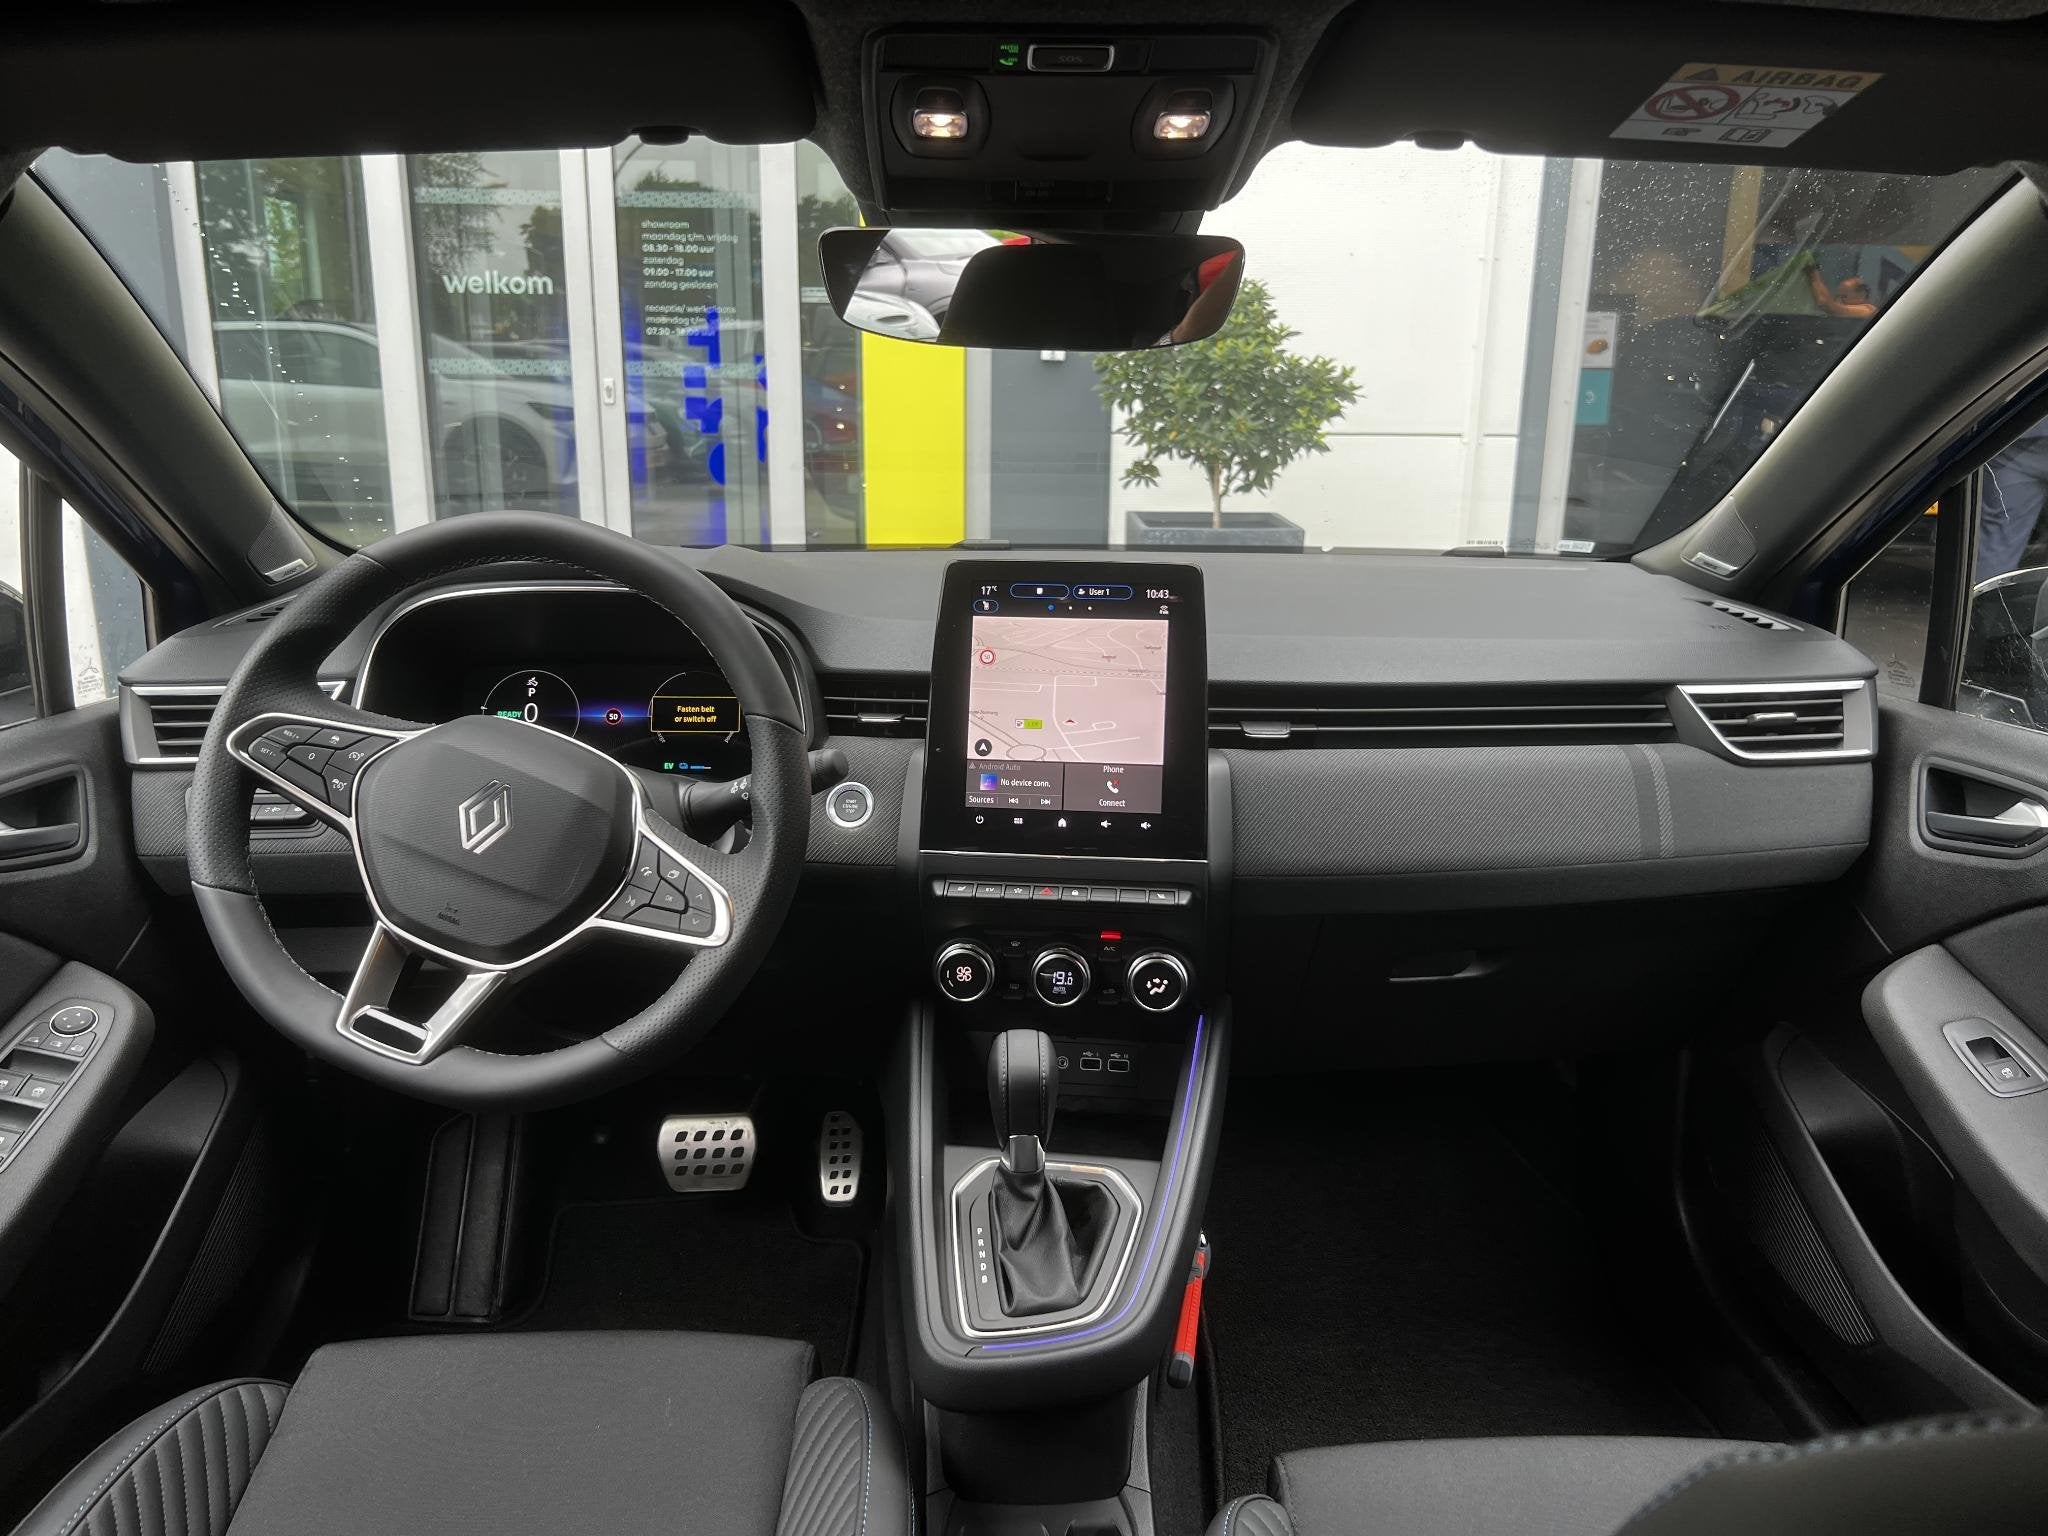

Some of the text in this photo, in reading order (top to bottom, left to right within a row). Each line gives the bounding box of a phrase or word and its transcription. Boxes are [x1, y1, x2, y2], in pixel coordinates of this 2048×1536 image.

[1059, 55, 1082, 63] SOS
[1732, 70, 1863, 88] AIRBAG
[641, 219, 690, 229] showroom
[641, 232, 687, 242] maandag
[706, 233, 739, 244] vrijdag
[699, 245, 715, 253] uur
[642, 256, 684, 266] zaterdag
[675, 268, 698, 276] 17.00
[698, 269, 714, 277] uur
[442, 271, 554, 295] welkom
[644, 280, 719, 291] zondag gesloten
[1089, 588, 1104, 596] User
[1145, 589, 1169, 599] 10:43
[528, 688, 536, 697] P
[524, 703, 538, 723] 0
[609, 713, 618, 721] 50
[683, 715, 703, 723] switch
[1005, 763, 1021, 771] Auto
[1103, 765, 1124, 774] Phone
[1000, 778, 1010, 786] No
[1011, 779, 1033, 787] device
[968, 795, 994, 804] Sources
[1099, 799, 1126, 807] Connect
[977, 1227, 983, 1235] P
[978, 1239, 984, 1247] R
[979, 1250, 986, 1258] N
[981, 1263, 987, 1271] D
